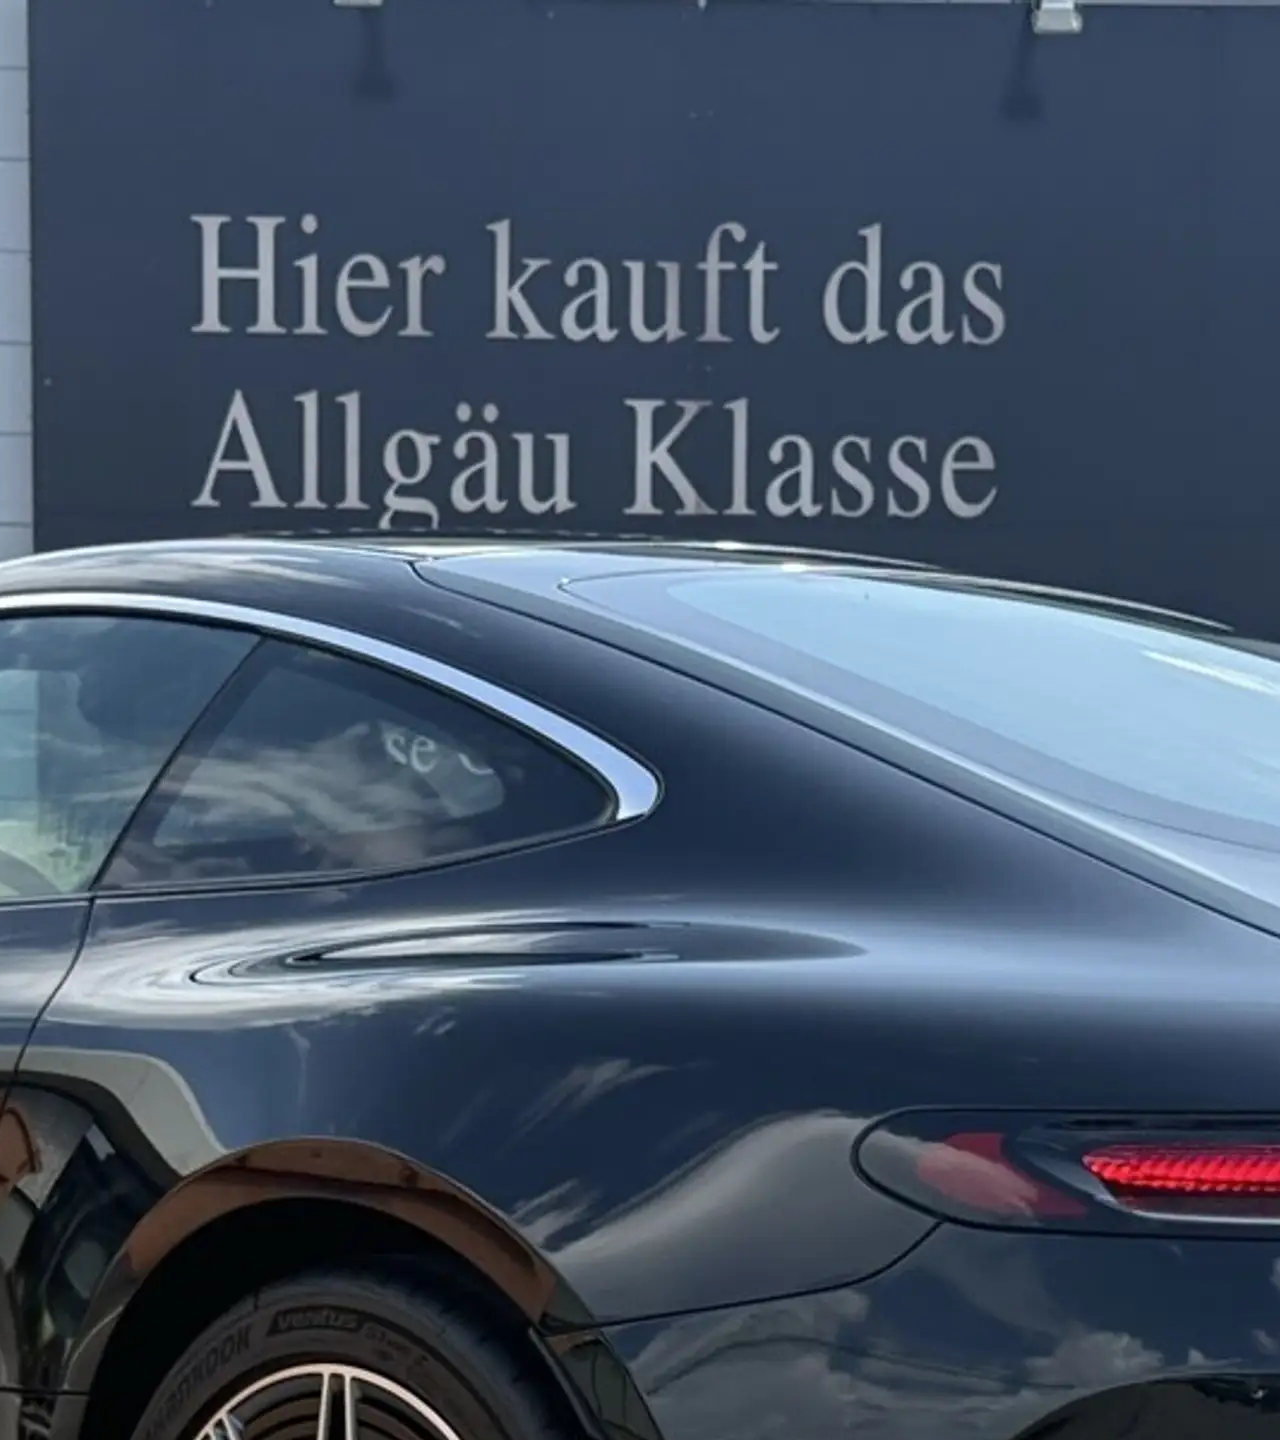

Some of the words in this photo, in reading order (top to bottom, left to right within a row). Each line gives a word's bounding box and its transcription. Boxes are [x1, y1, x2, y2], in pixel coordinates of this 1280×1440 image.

[189, 212, 446, 339] Hier
[485, 218, 781, 344] kauft
[822, 222, 1008, 347] das
[190, 387, 577, 531] Allgäu
[623, 397, 1001, 519] Klasse
